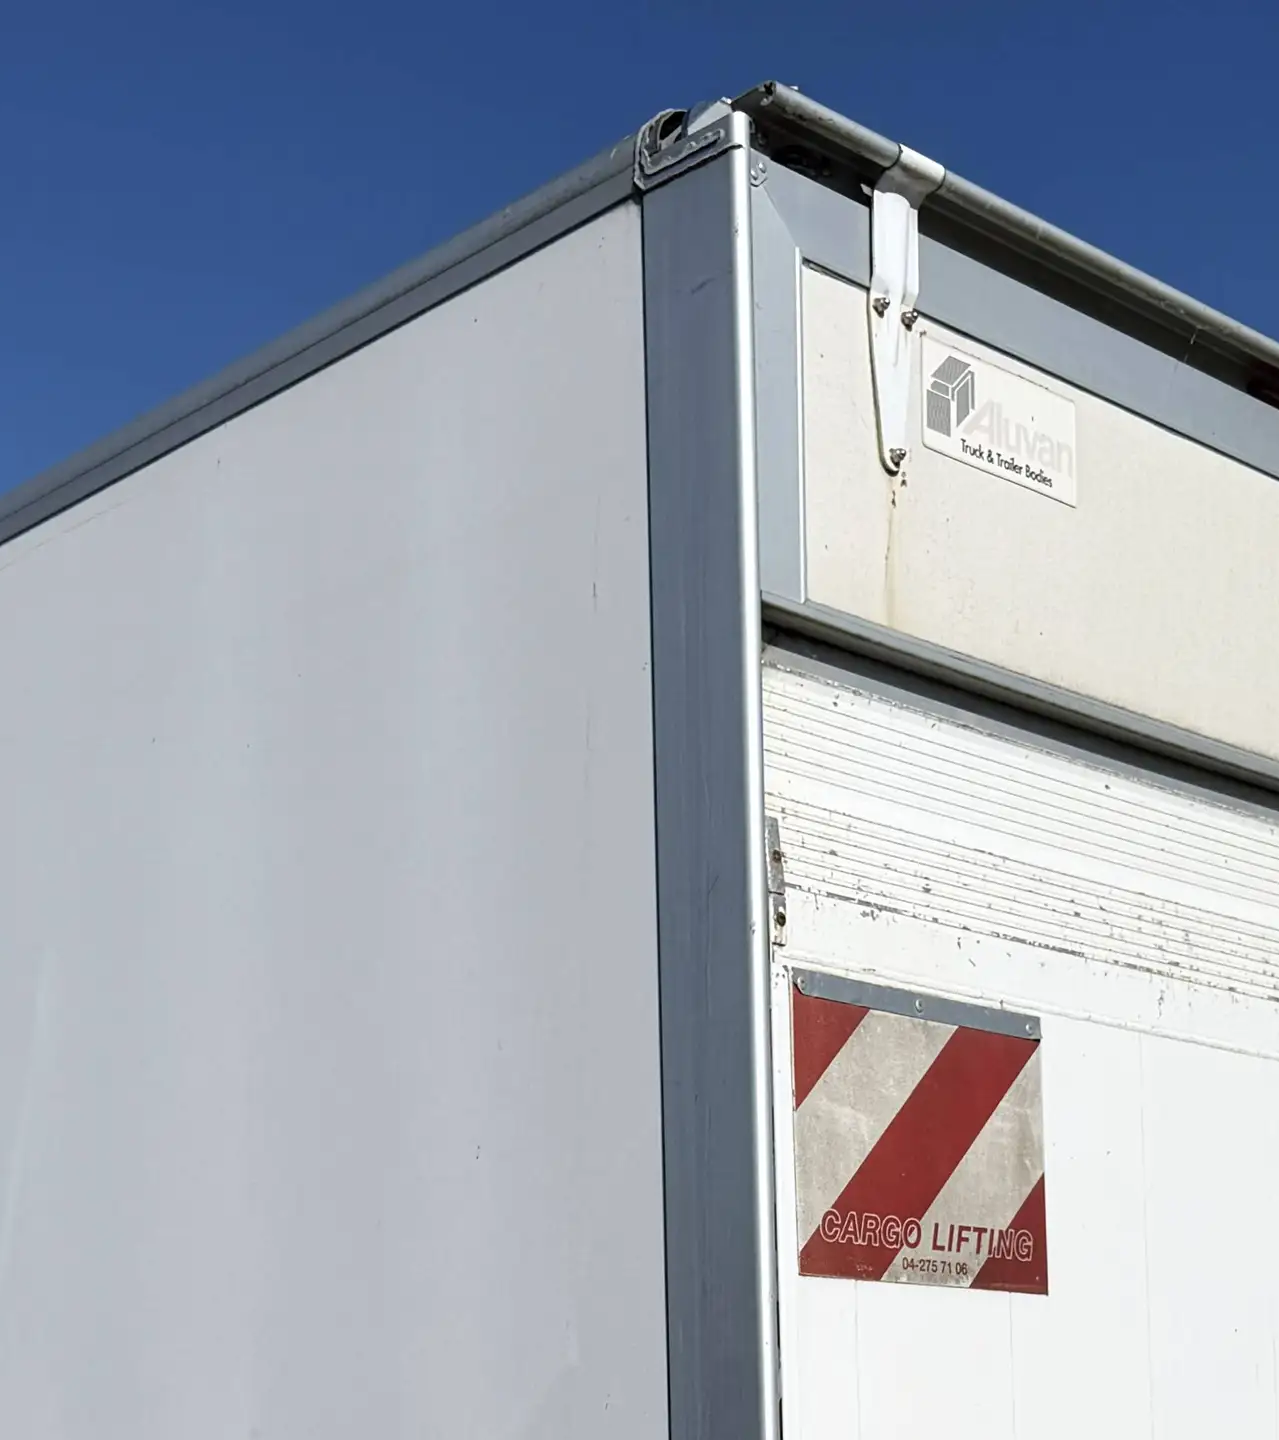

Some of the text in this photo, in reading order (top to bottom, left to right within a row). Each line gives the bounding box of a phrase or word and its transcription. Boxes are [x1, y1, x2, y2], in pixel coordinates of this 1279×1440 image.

[960, 438, 1053, 488] Truck & Trailer Bodies
[962, 399, 1073, 478] Aluvan
[820, 1208, 1034, 1262] CARGO LIFTING
[902, 1257, 968, 1275] 04-275 71 06
